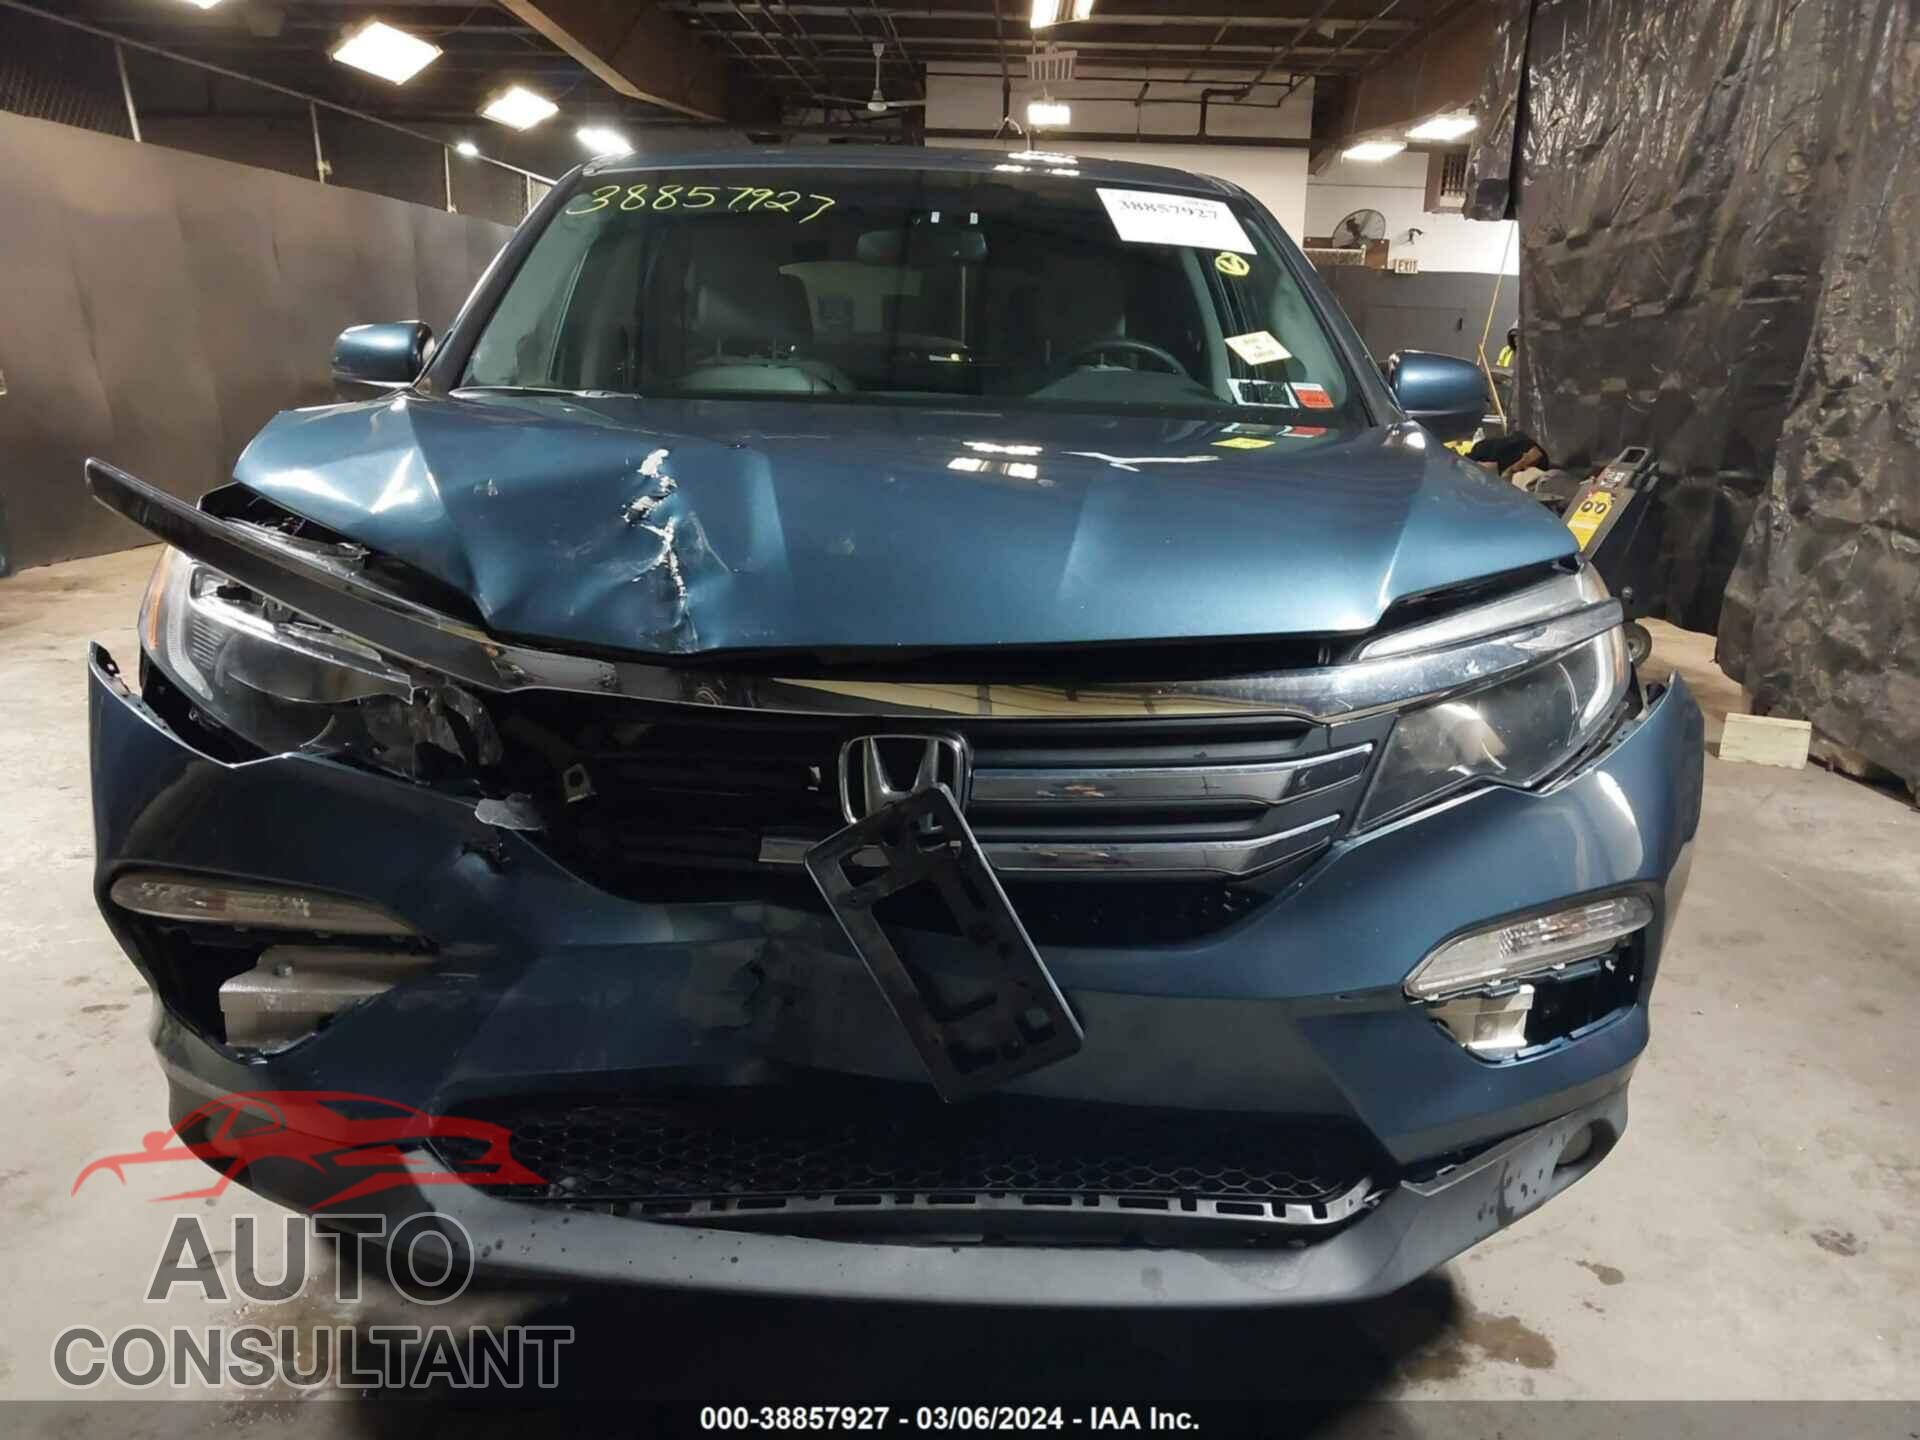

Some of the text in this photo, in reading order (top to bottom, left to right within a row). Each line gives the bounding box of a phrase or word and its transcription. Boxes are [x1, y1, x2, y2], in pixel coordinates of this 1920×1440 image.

[565, 184, 836, 224] 38857927
[1119, 199, 1218, 220] 38857927
[1397, 258, 1418, 272] EXIT
